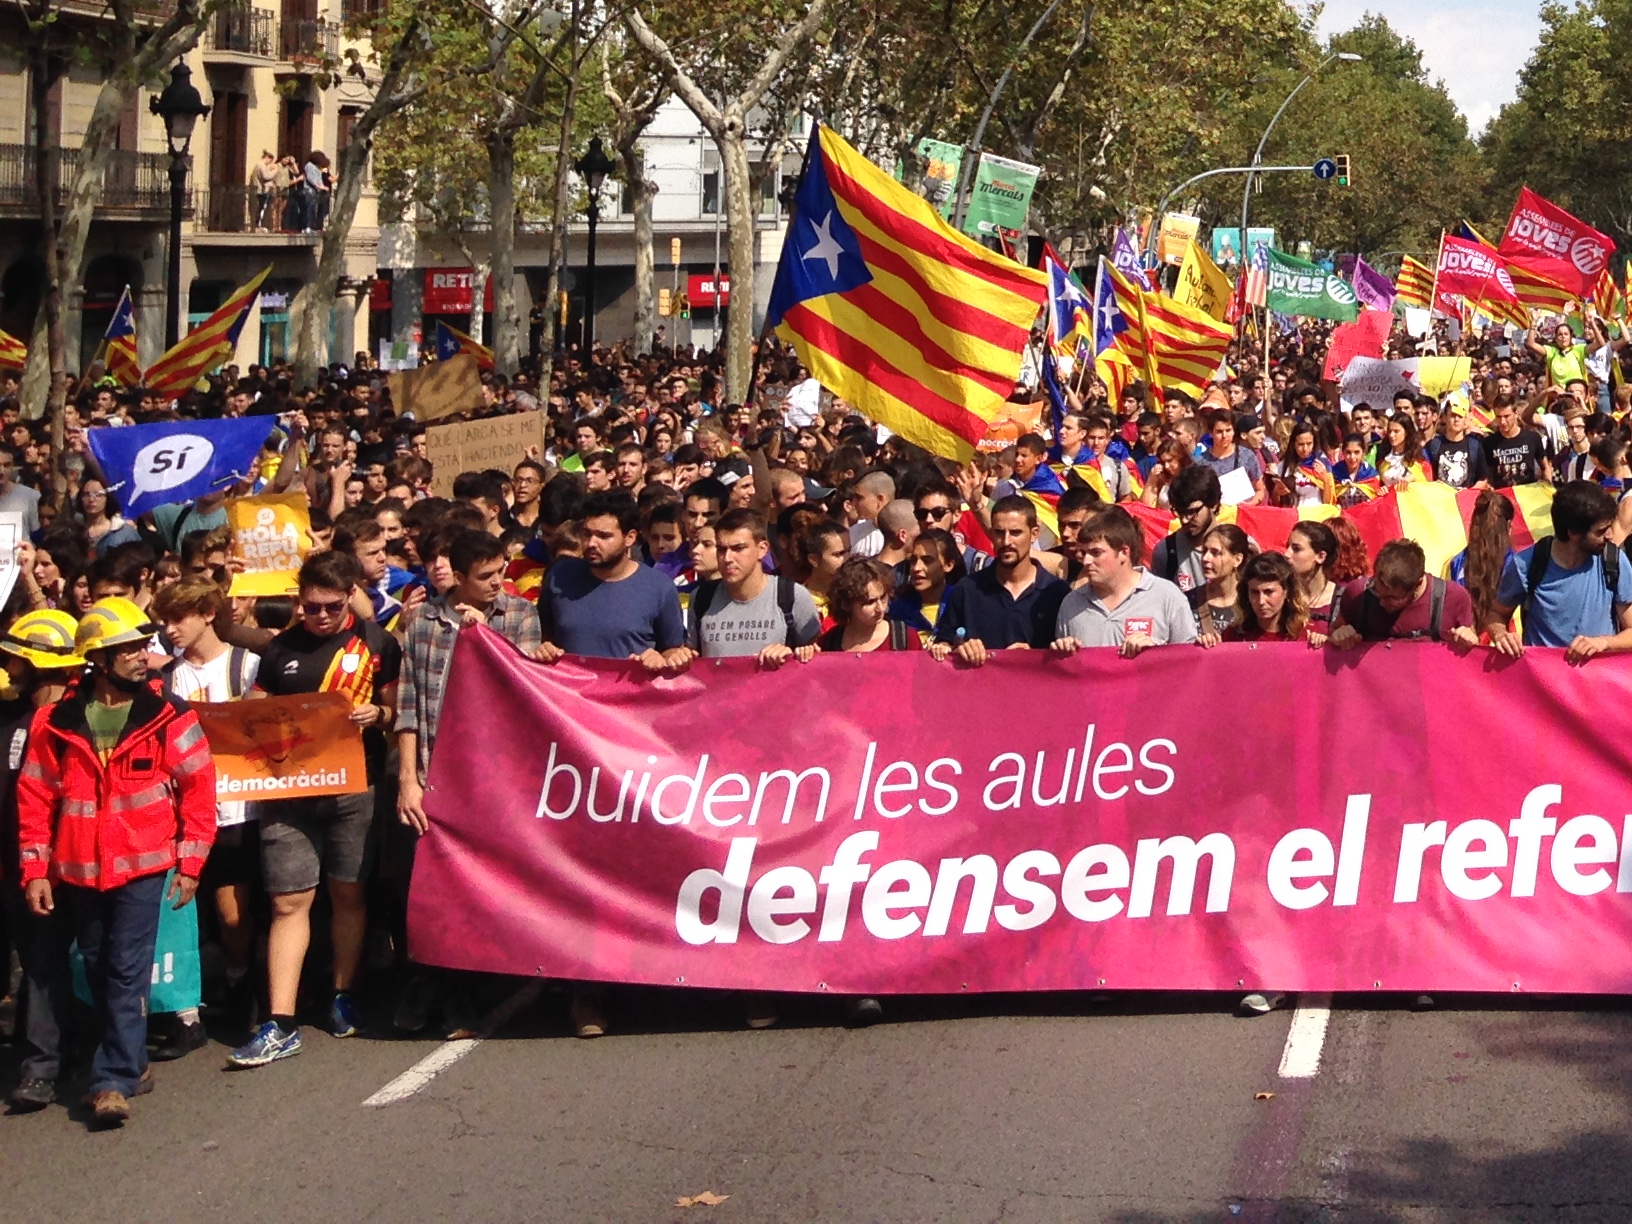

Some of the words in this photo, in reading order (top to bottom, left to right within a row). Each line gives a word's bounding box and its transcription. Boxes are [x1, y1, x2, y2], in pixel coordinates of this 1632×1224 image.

[979, 181, 1025, 202] Mercats
[237, 523, 298, 543] HOLA
[705, 622, 716, 630] NO
[721, 621, 734, 630] EM
[709, 633, 720, 642] DE
[725, 632, 767, 641] GENOLLS
[216, 768, 346, 793] democràcia!
[536, 742, 831, 824] buidem
[854, 742, 961, 819] les
[983, 724, 1176, 810] aules
[675, 830, 1235, 945] defensem
[1267, 793, 1372, 909] el
